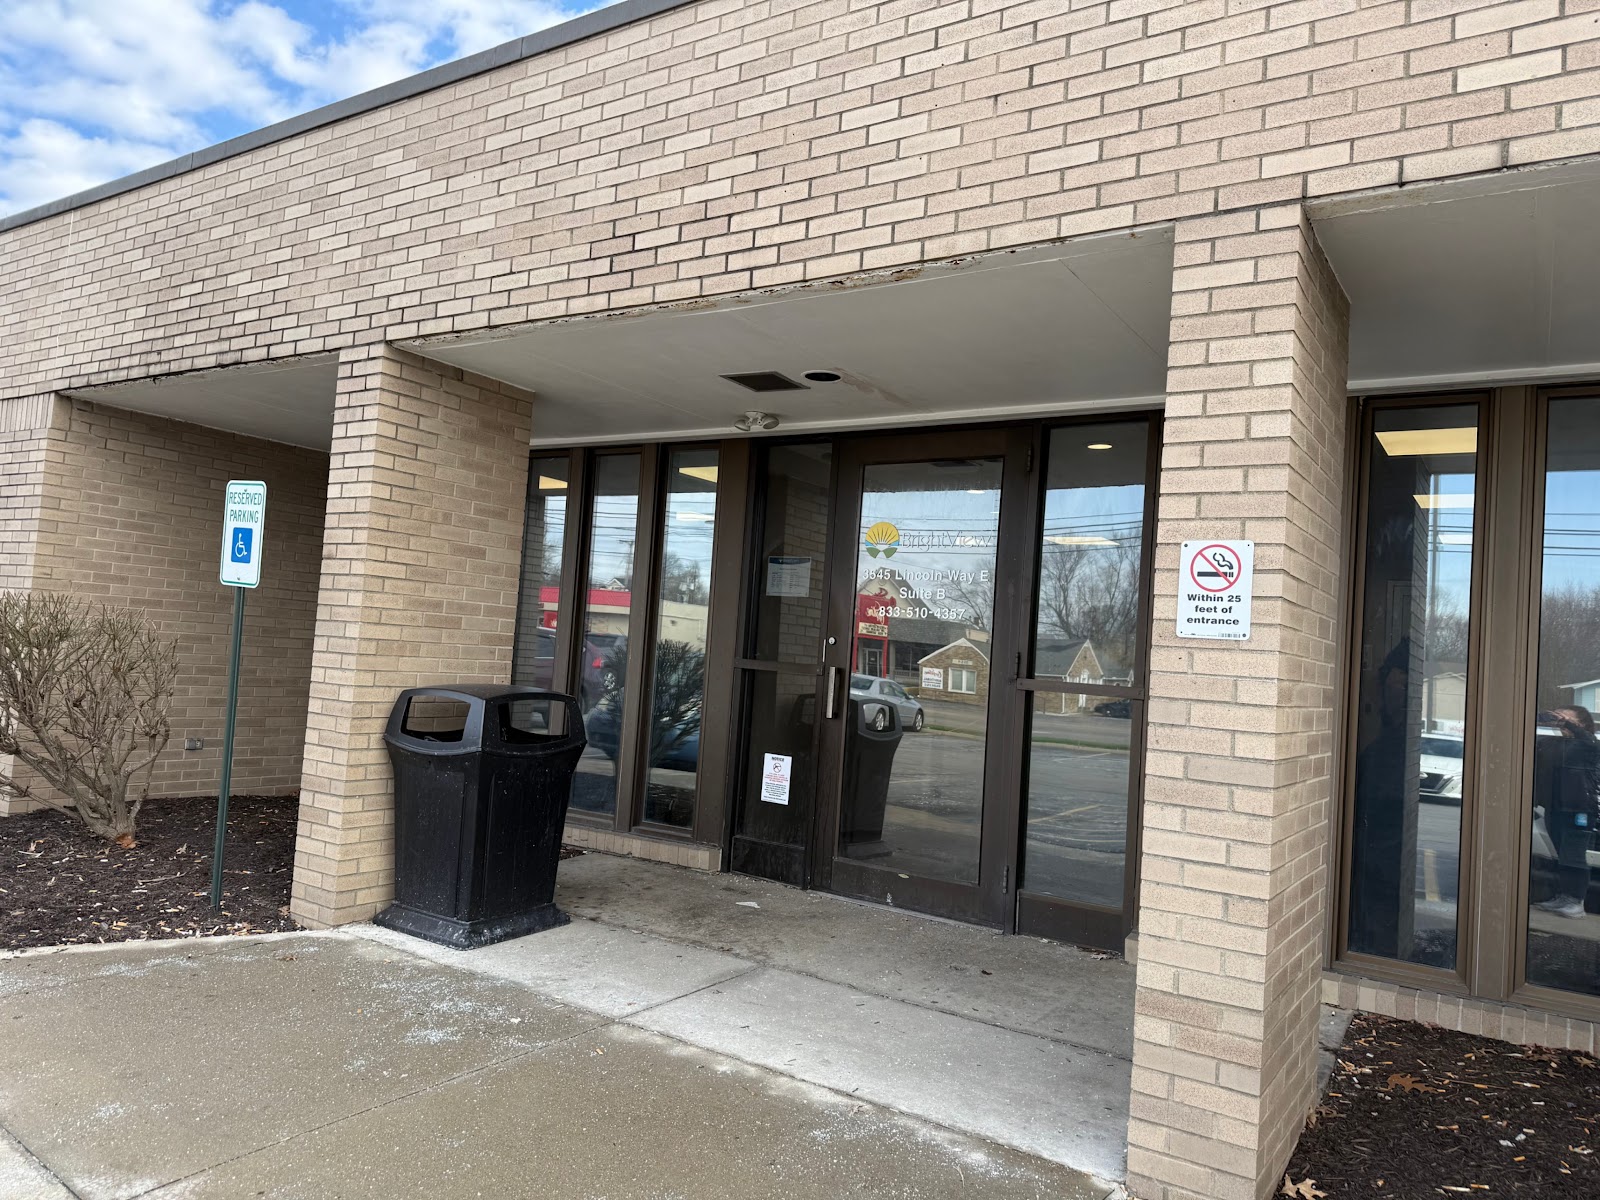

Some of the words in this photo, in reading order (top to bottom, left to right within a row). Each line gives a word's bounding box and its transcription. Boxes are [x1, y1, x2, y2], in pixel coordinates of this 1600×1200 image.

[229, 492, 262, 505] RESERVED
[230, 510, 259, 523] PARKING
[902, 531, 992, 552] BrightView
[895, 569, 943, 581] Lincoln
[948, 569, 975, 584] Way
[980, 570, 989, 581] E
[899, 587, 932, 600] Suite
[936, 588, 946, 600] B
[1187, 593, 1224, 602] Within
[1227, 595, 1242, 603] 25
[879, 606, 966, 620] 833-510-4357
[1194, 605, 1218, 613] feet
[1186, 616, 1240, 625] entrance
